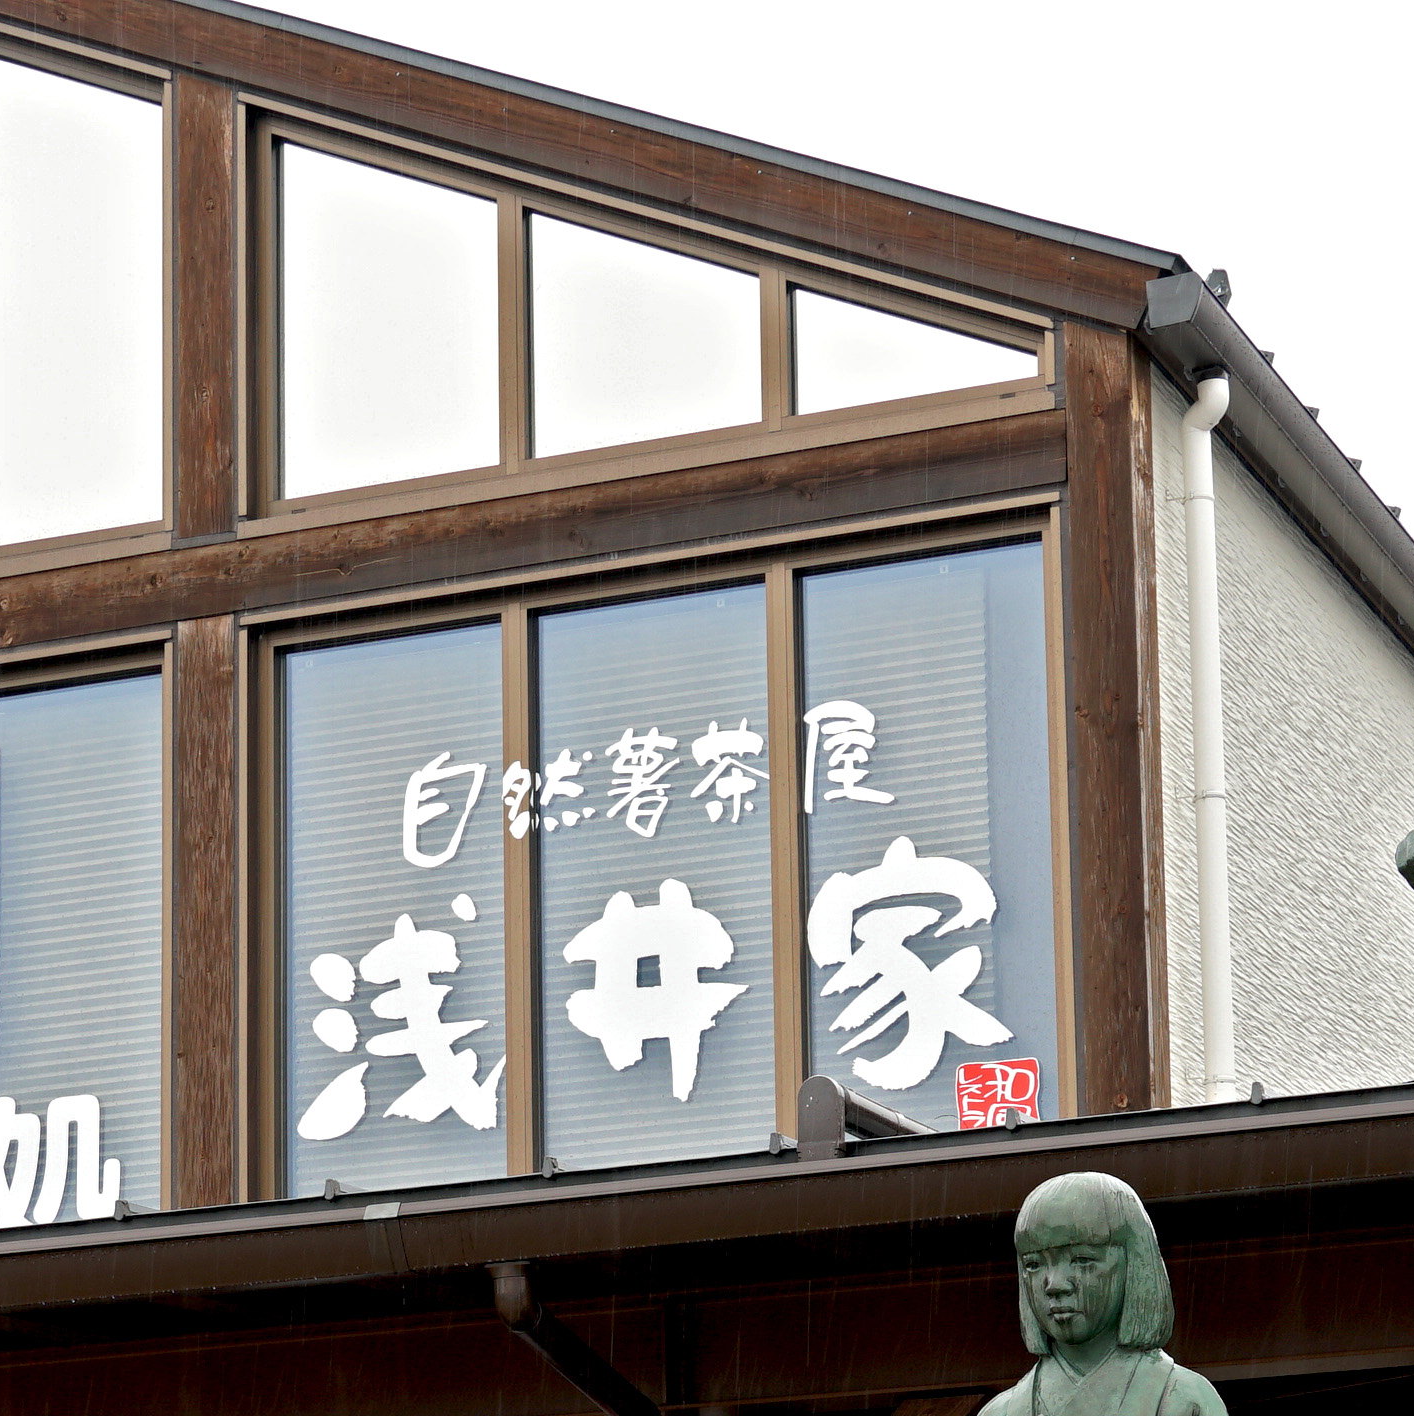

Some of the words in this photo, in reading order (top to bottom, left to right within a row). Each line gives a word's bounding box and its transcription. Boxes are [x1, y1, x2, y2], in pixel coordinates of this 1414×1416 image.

[402, 700, 895, 868] 自然薯茶屋
[296, 835, 1014, 1141] 浅井家
